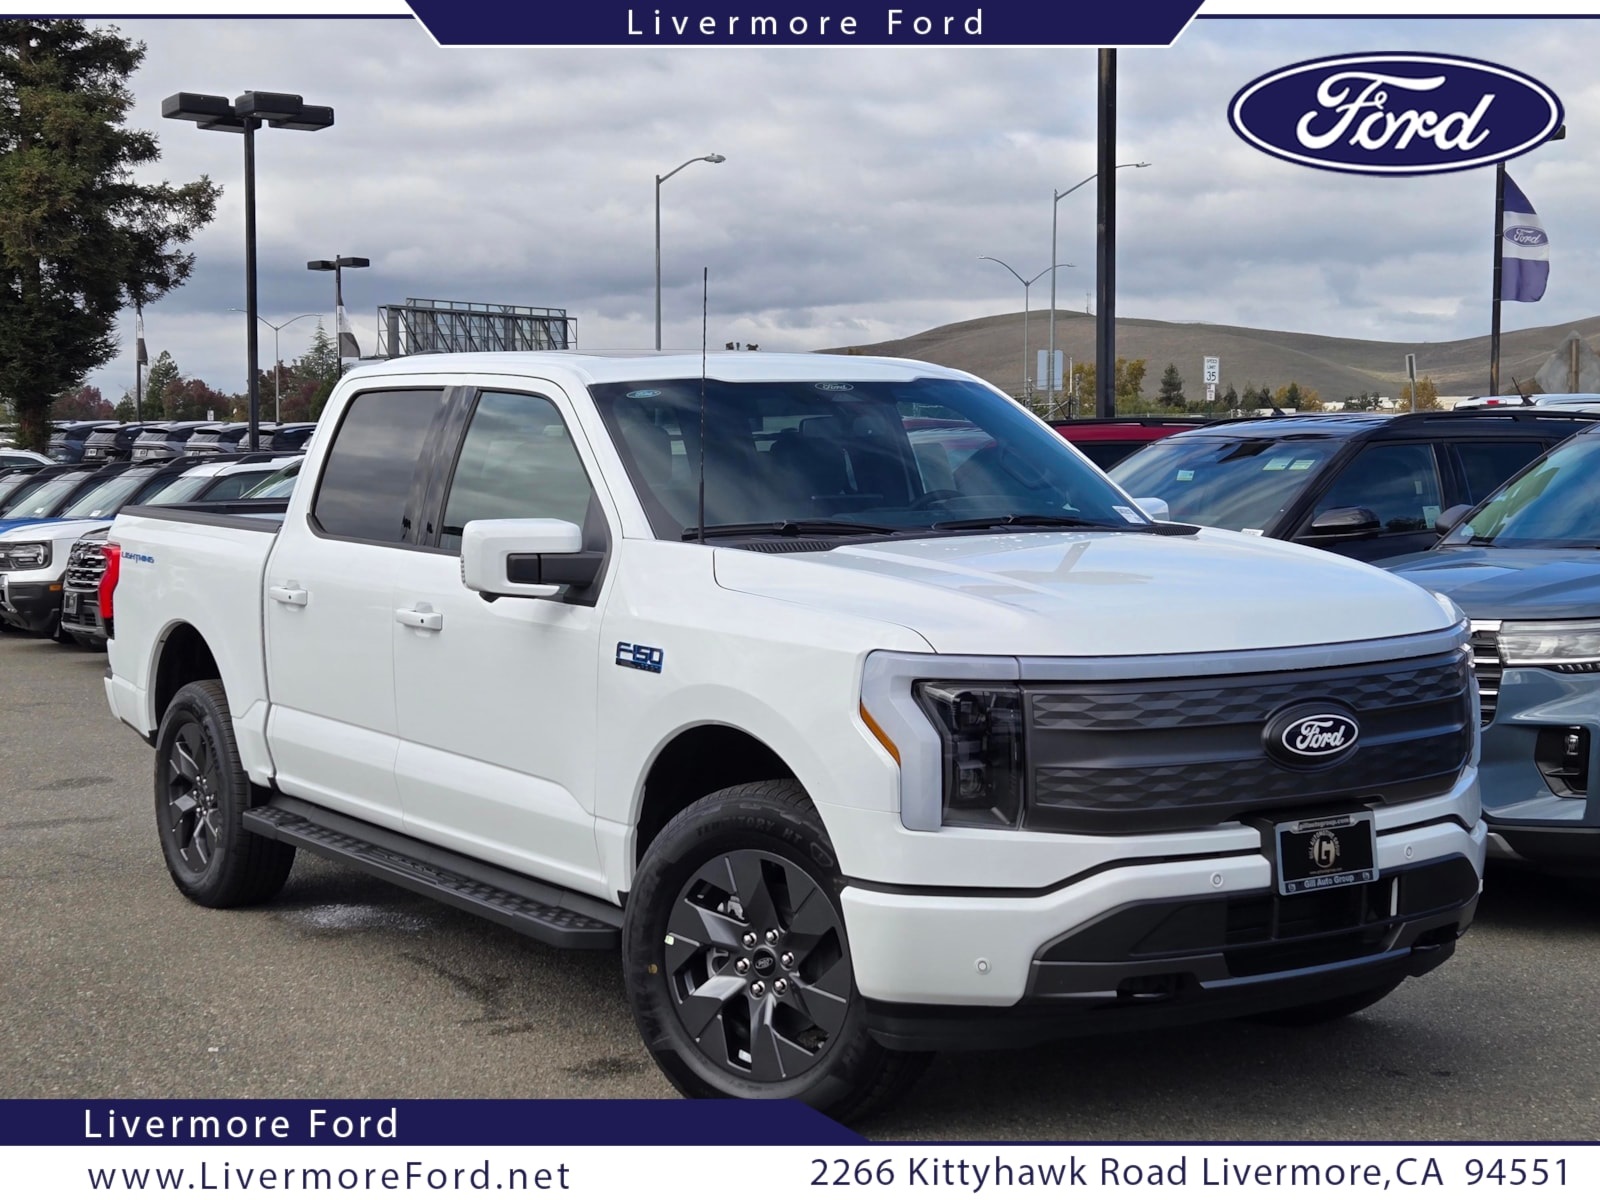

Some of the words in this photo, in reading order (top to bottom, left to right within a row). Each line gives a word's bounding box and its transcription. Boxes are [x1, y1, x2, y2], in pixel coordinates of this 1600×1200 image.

[1513, 228, 1541, 244] Ford
[1206, 371, 1217, 381] 35
[1296, 720, 1345, 750] Ford
[1303, 879, 1317, 889] Gill
[1316, 877, 1333, 887] Auto
[1334, 875, 1355, 884] Group
